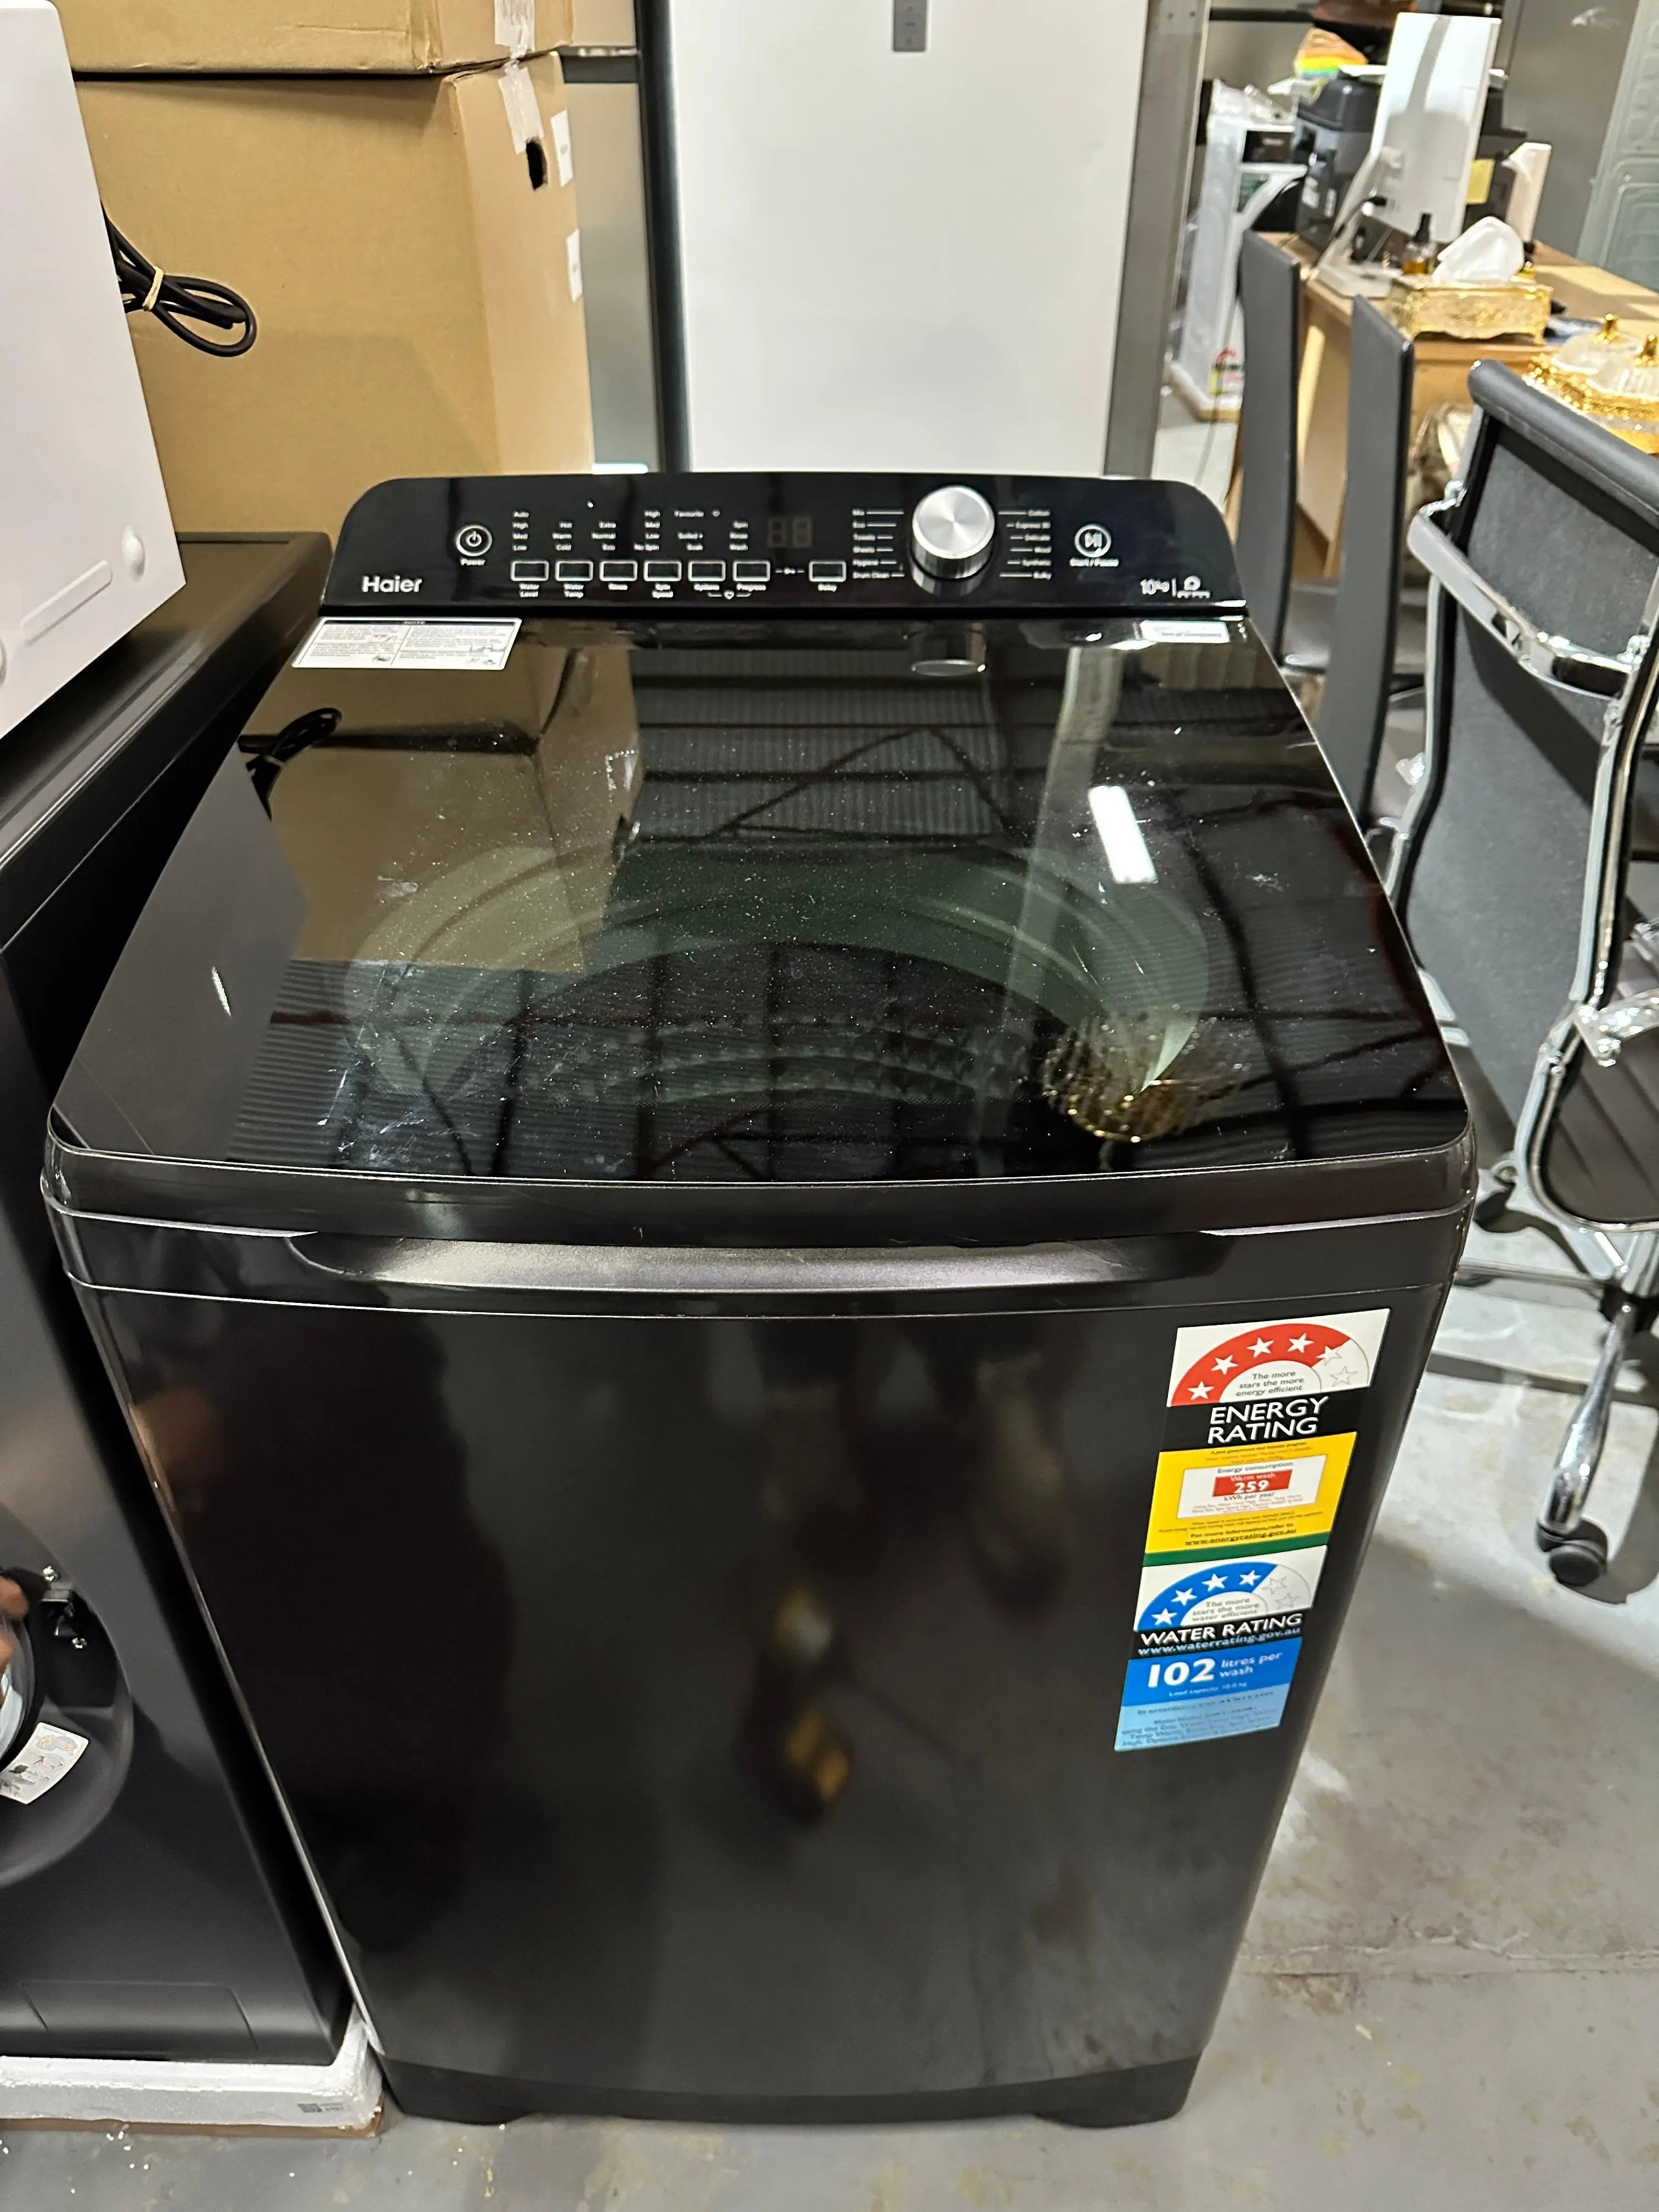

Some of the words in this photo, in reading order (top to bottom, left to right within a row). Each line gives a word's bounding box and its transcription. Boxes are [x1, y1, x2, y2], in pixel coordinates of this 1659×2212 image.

[644, 510, 661, 518] High
[512, 522, 529, 530] High
[460, 557, 486, 566] Power
[1069, 558, 1090, 567] Start
[362, 574, 422, 592] Haier
[1268, 1385, 1304, 1394] efficient
[1209, 1396, 1330, 1425] ENERGY
[1207, 1416, 1319, 1445] RATING
[1244, 1460, 1294, 1472] consumption
[1233, 1479, 1270, 1494] 259
[1185, 1528, 1297, 1546] www.energyrating.gov.au
[1221, 1609, 1257, 1618] efficient
[1141, 1626, 1216, 1645] WATER
[1222, 1613, 1303, 1637] RATING
[1138, 1627, 1301, 1656] www.waterrating.gov.au
[1148, 1658, 1216, 1688] 102
[1221, 1657, 1255, 1668] litres
[1259, 1652, 1283, 1664] per
[1220, 1666, 1254, 1677] wash
